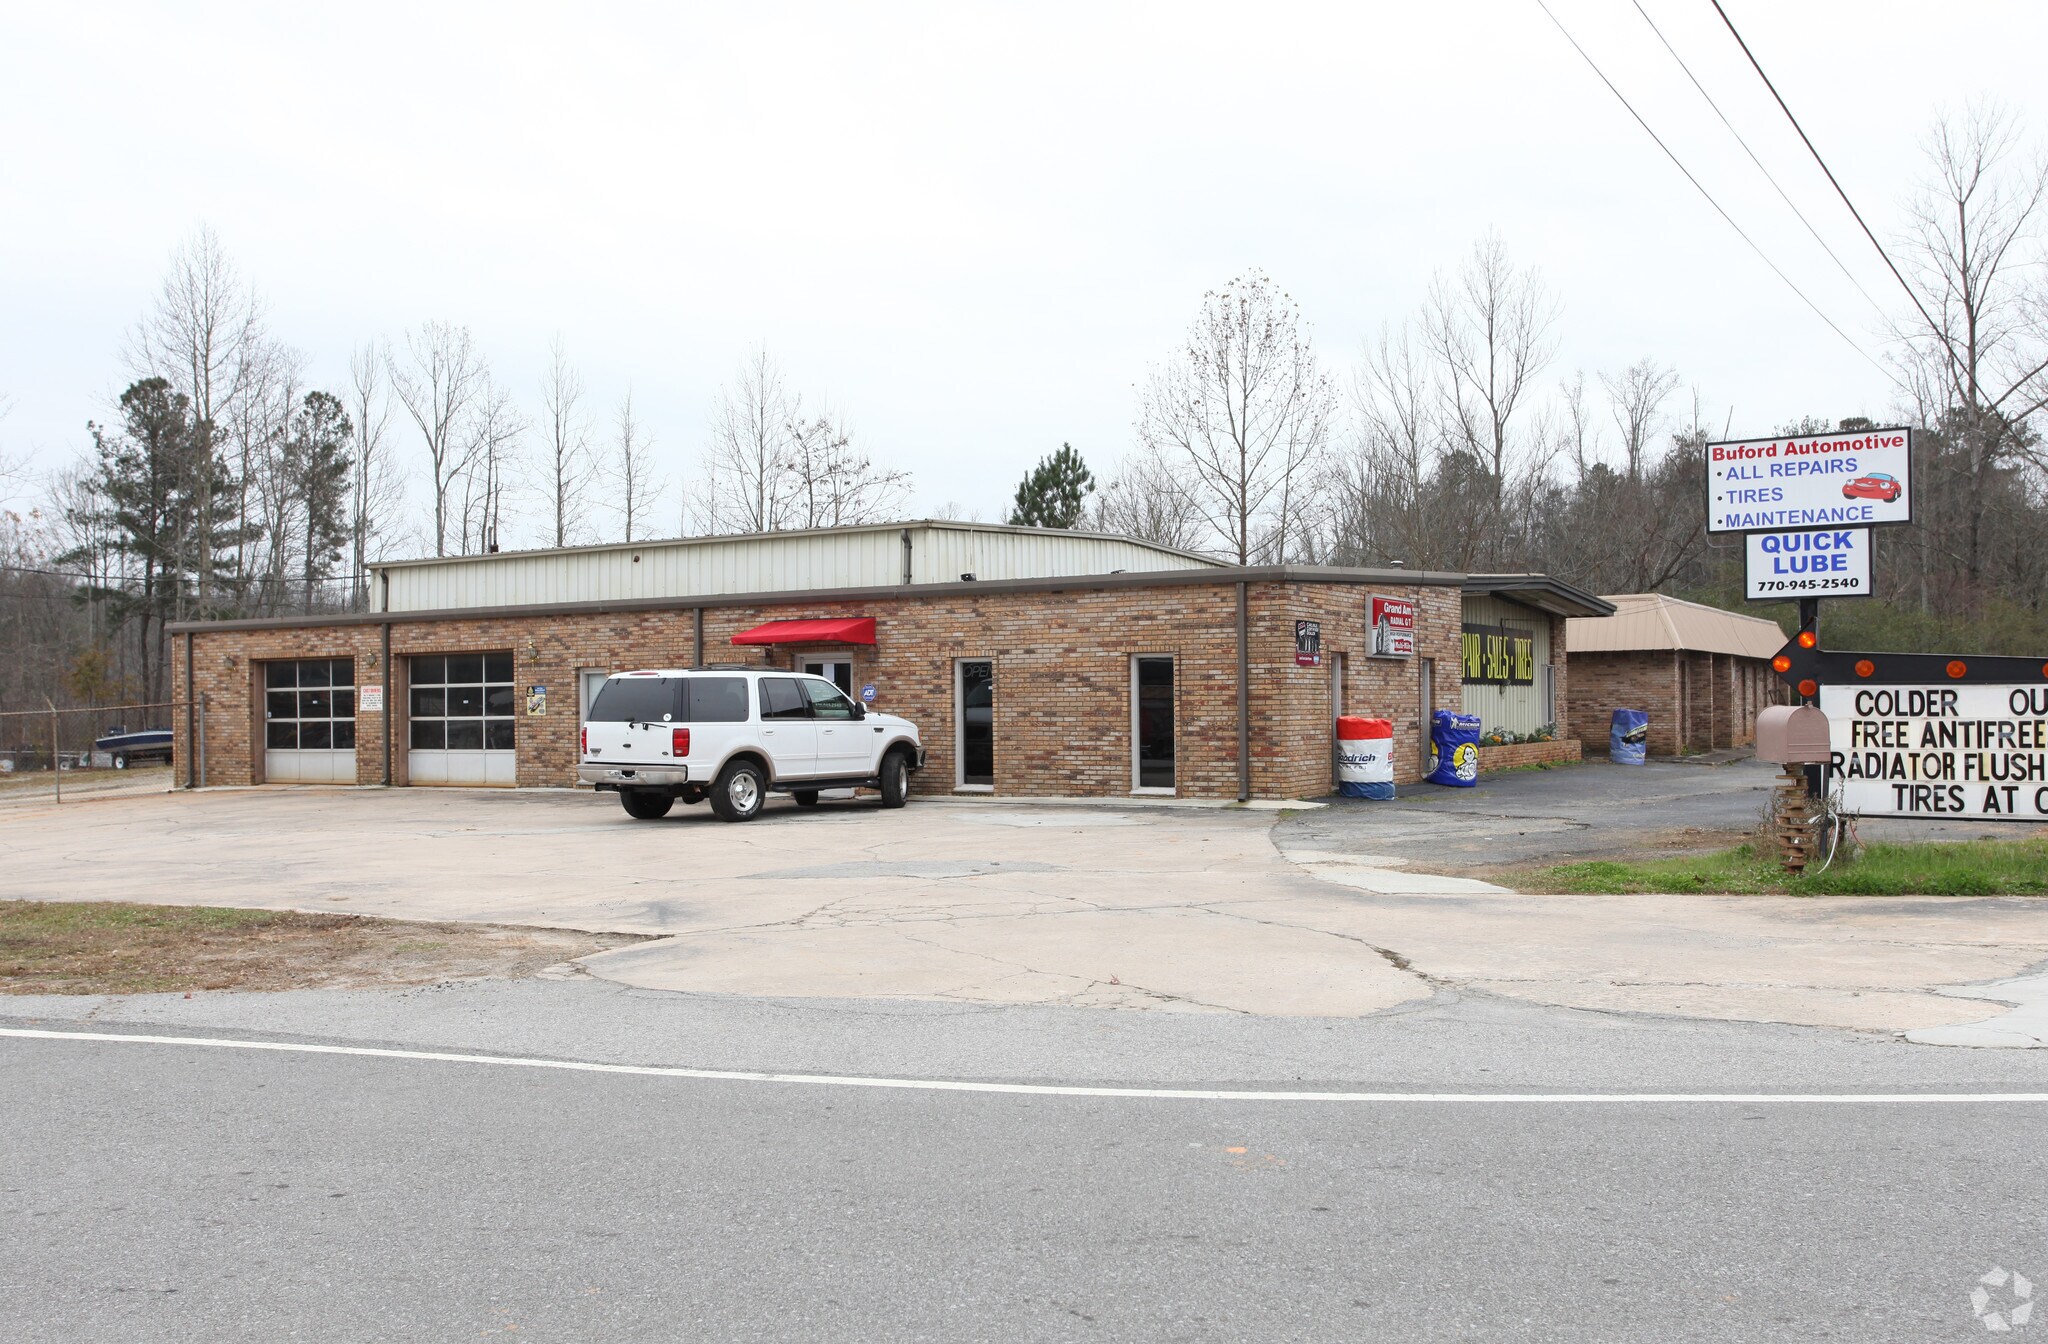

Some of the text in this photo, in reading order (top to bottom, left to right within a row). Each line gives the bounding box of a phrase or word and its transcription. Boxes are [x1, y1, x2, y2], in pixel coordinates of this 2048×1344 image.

[1712, 434, 1904, 461] Buford Automotive
[1726, 458, 1858, 480] ALL REPAIRS
[1726, 487, 1783, 504] TIRES
[1726, 506, 1873, 527] MAINTENANCE
[1761, 531, 1853, 554] QUICK
[1773, 553, 1847, 574] LUBE
[1757, 578, 1859, 591] 770-945-2540
[1384, 602, 1412, 615] Grand Am
[1487, 634, 1509, 679] SALES
[1514, 637, 1533, 680] TIRES
[1855, 689, 1959, 717] COLDER
[1851, 719, 2048, 749] FREE ANTIFREE
[1829, 751, 2045, 781] RADIATOR FLUSH
[1891, 784, 1964, 812] TIRES
[1982, 785, 2019, 813] AT
